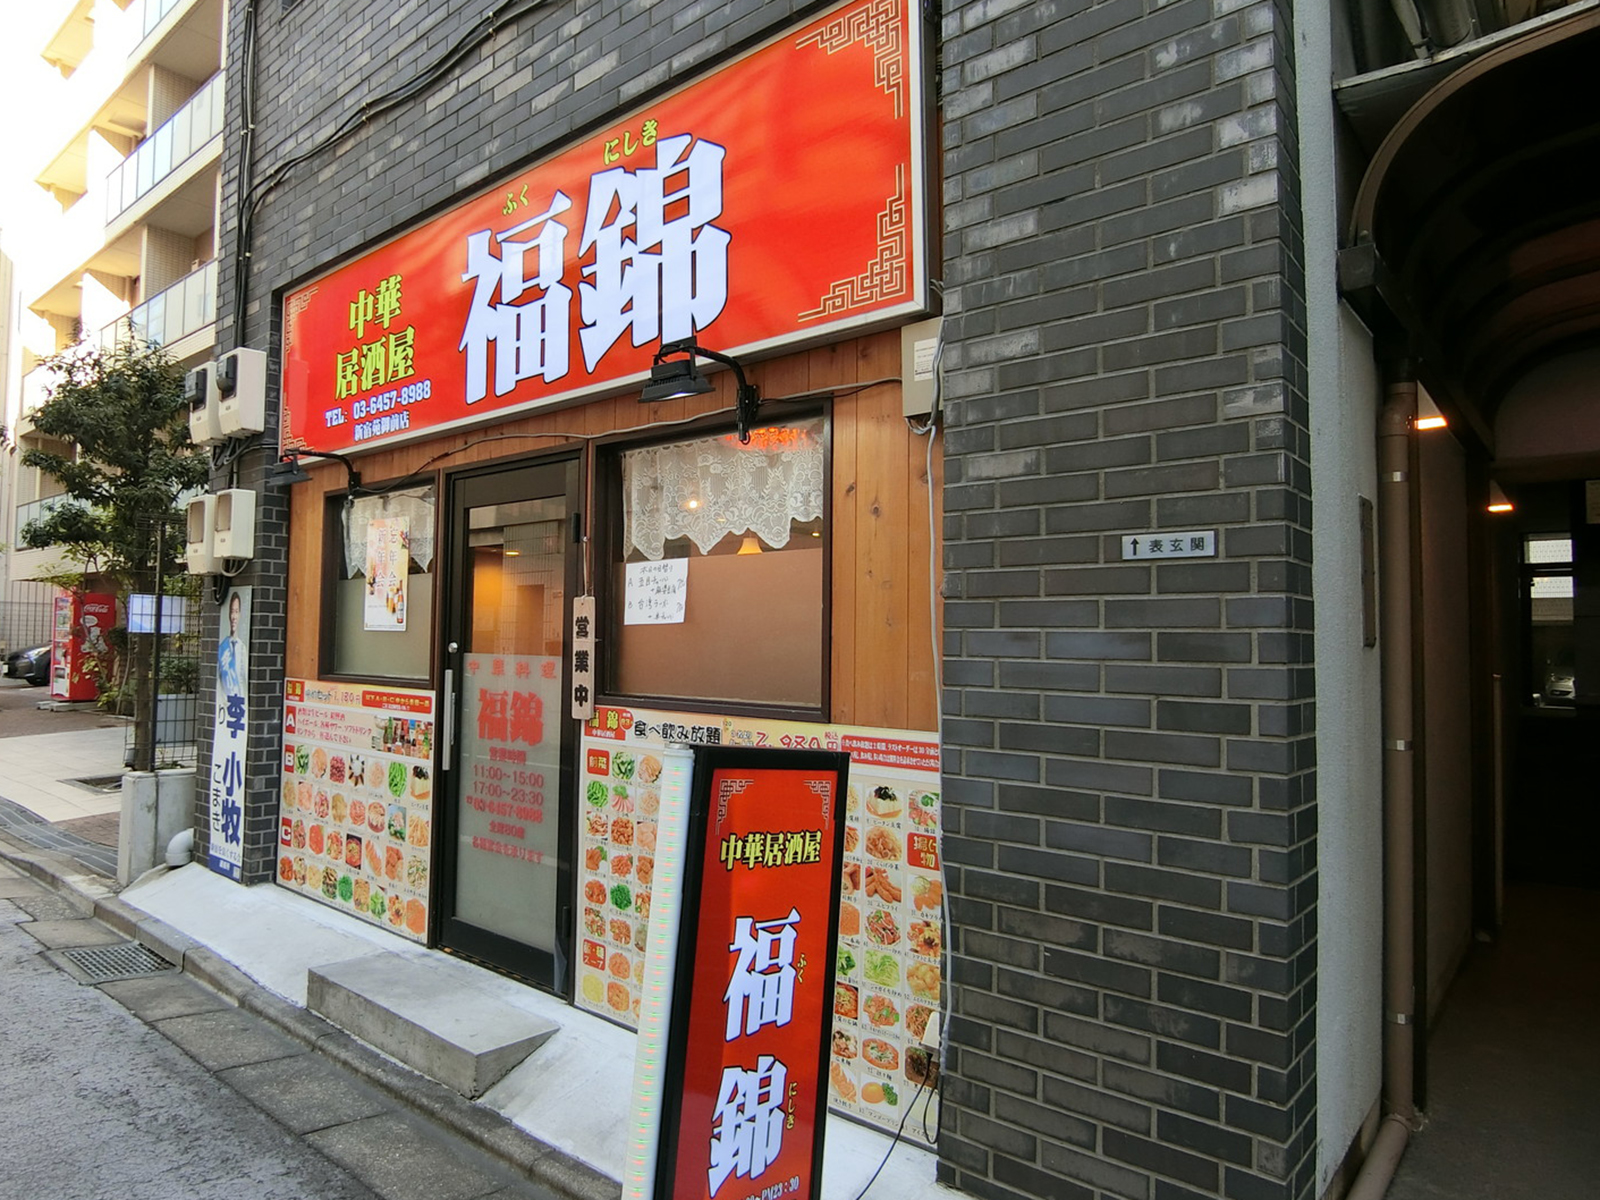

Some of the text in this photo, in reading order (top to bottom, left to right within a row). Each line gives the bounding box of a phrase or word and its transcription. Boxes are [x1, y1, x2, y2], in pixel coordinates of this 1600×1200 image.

[603, 119, 658, 165] にしき
[502, 184, 529, 215] ふく
[459, 133, 732, 405] 福錦
[348, 274, 402, 339] 中華
[335, 325, 415, 399] 居酒屋
[352, 379, 431, 420] 03-6457-8988
[1149, 537, 1204, 553] 表玄関
[467, 659, 557, 680] 中華料理
[574, 616, 590, 708] 営業中
[218, 704, 226, 725] り
[226, 692, 245, 739] 李
[286, 713, 295, 727] A
[477, 688, 544, 747] 福錦
[634, 719, 721, 745] 食べ飲み放題
[285, 751, 293, 763] B
[211, 763, 222, 832] こまき
[221, 751, 243, 847] 小牧
[281, 826, 291, 840] C
[720, 830, 822, 871] 中華居酒屋
[920, 852, 936, 868] 物
[796, 952, 807, 984] ふく
[708, 907, 801, 1198] 福錦
[786, 1081, 798, 1130] にしき
